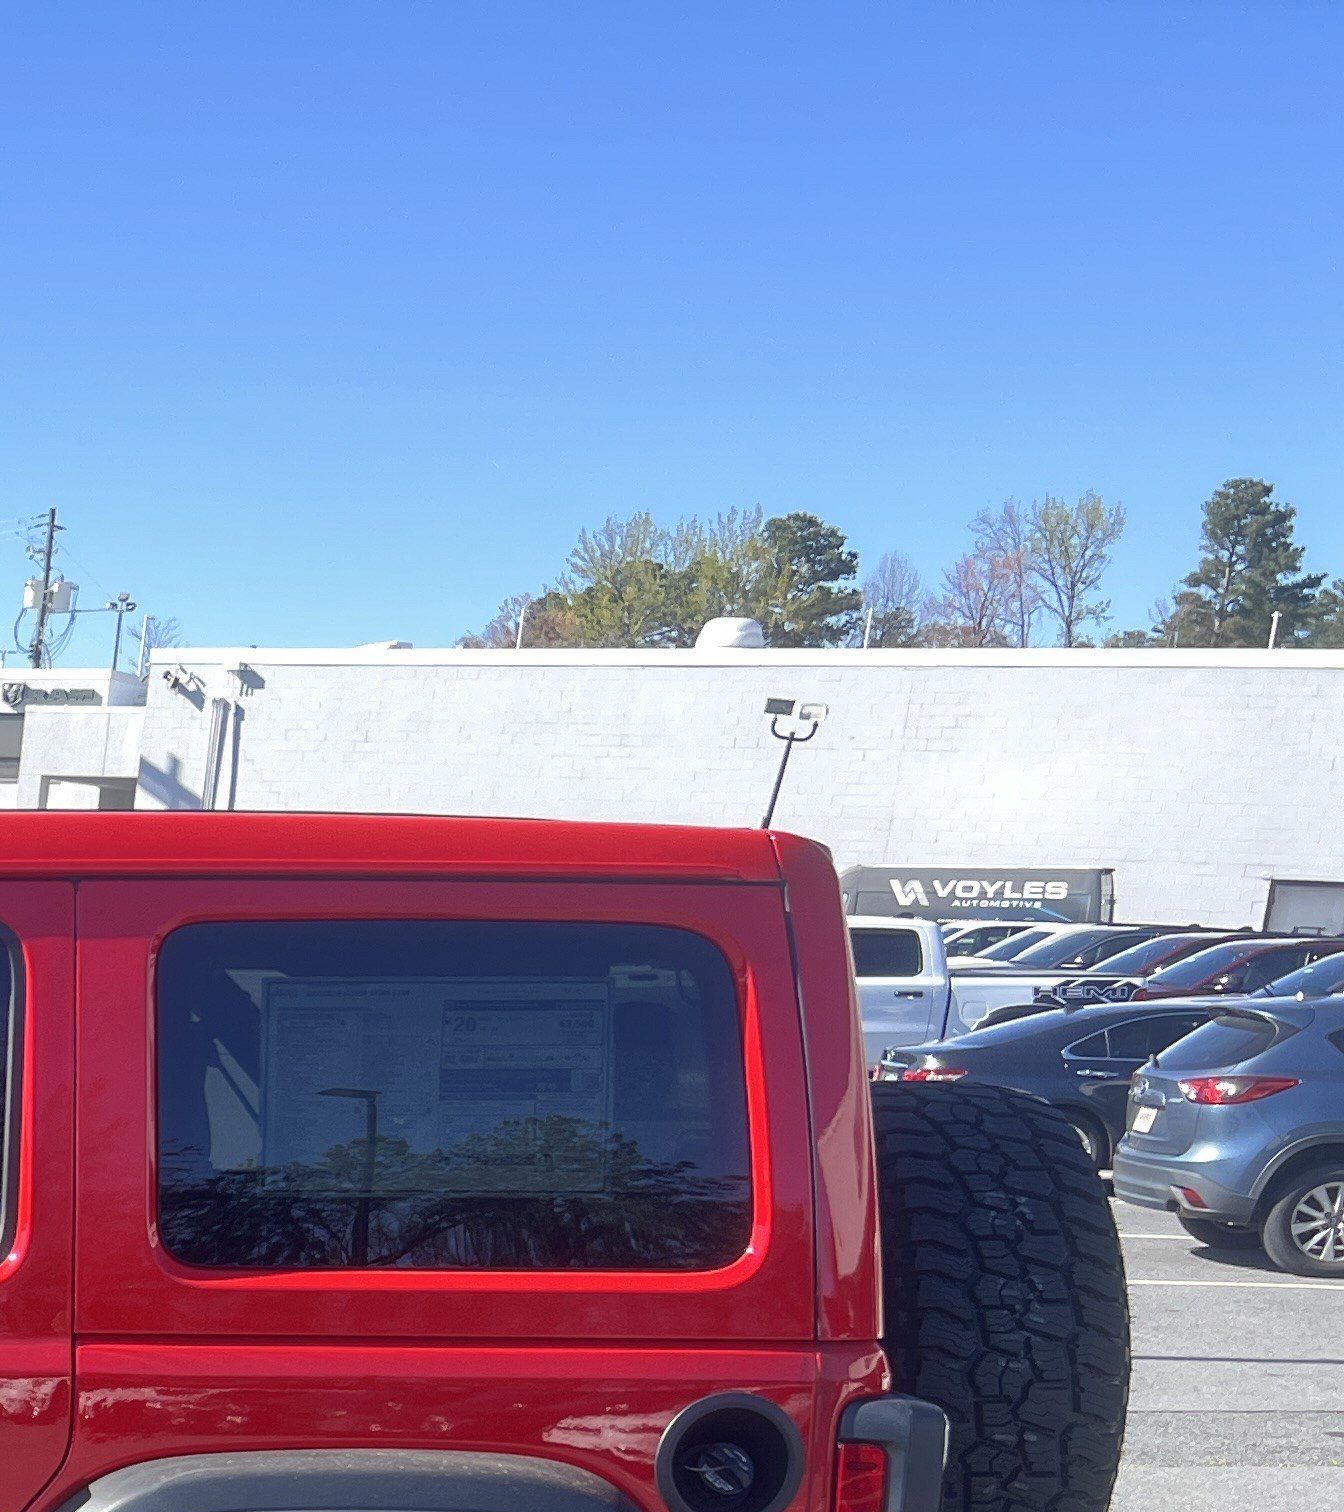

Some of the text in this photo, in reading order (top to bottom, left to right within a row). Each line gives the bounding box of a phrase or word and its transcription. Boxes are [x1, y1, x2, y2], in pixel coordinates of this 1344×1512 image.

[932, 880, 1069, 900] VOYLES
[951, 898, 1043, 909] AUTOMOTIVE
[1032, 986, 1128, 999] HEMI
